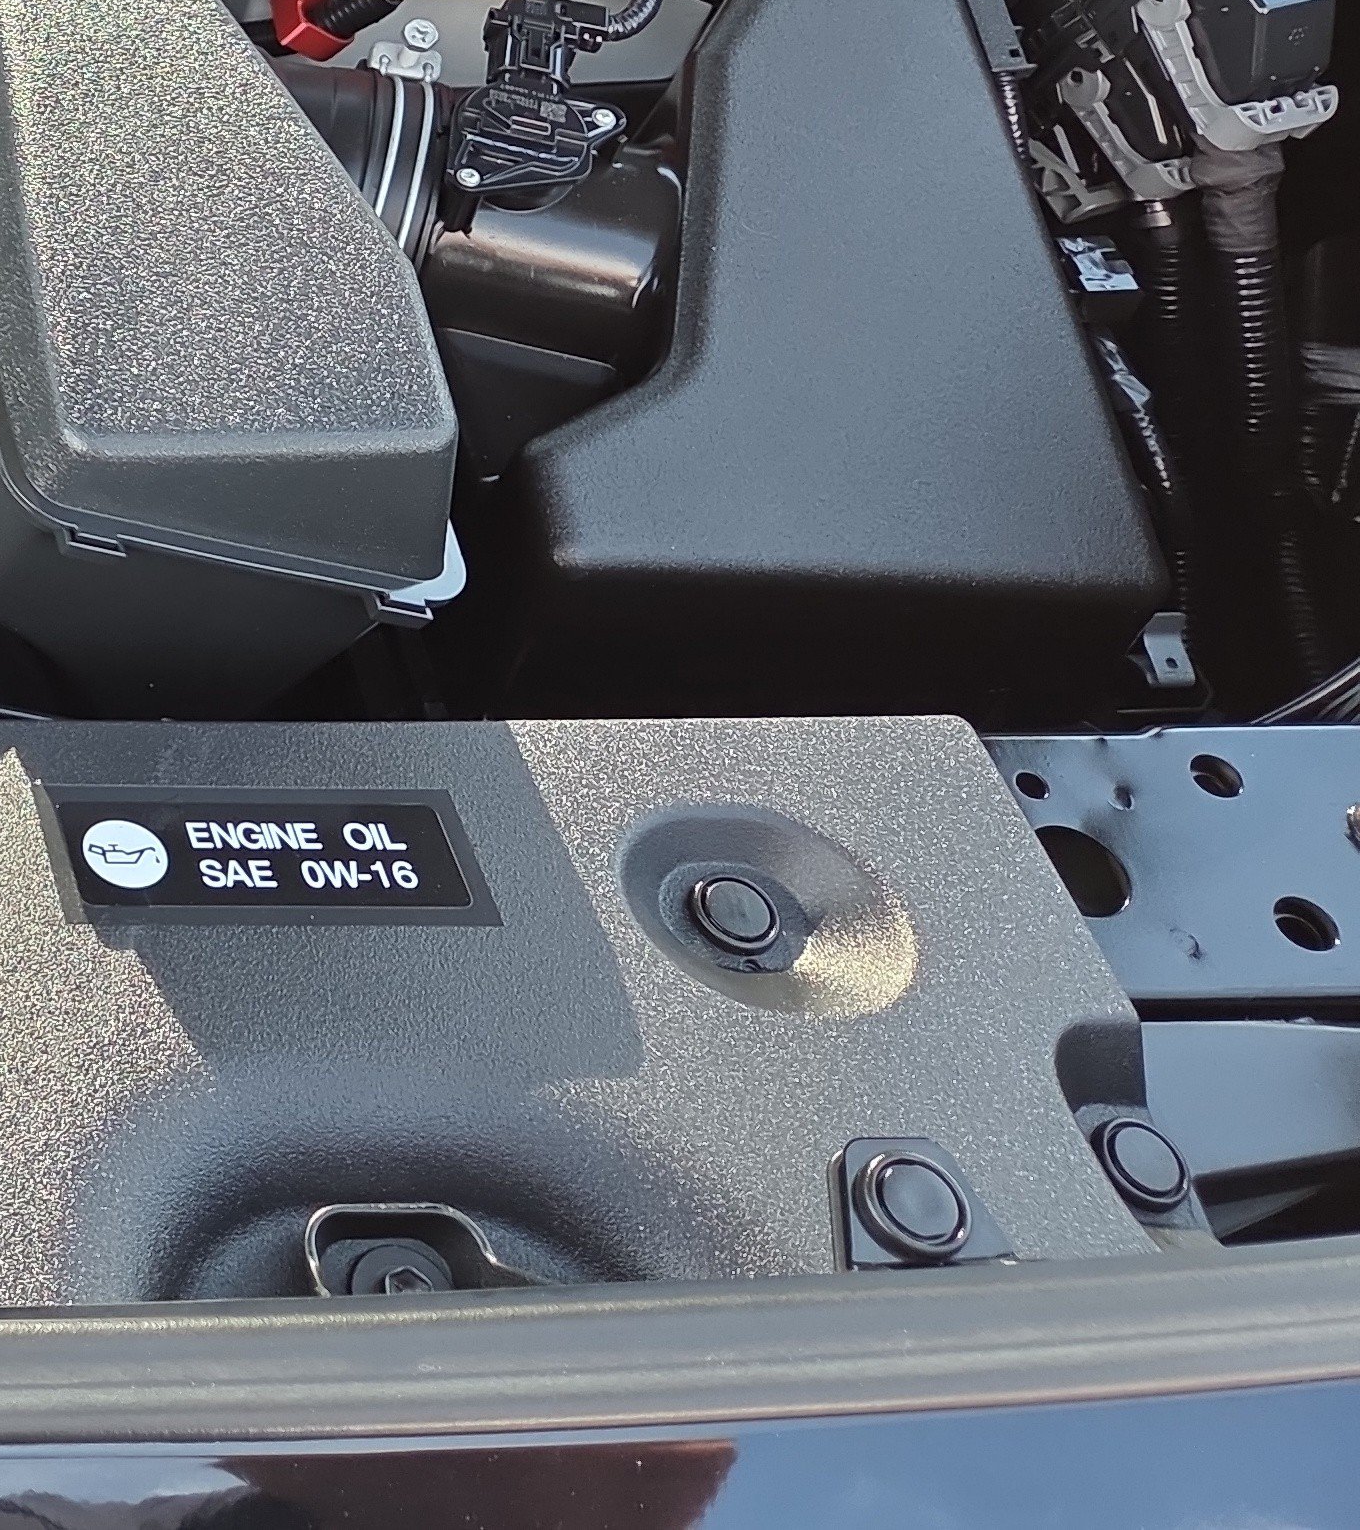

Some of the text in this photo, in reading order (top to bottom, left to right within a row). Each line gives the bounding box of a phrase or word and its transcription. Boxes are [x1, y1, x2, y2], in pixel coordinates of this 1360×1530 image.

[184, 821, 408, 851] ENGINE OIL
[198, 858, 420, 890] SAE 0W-16
